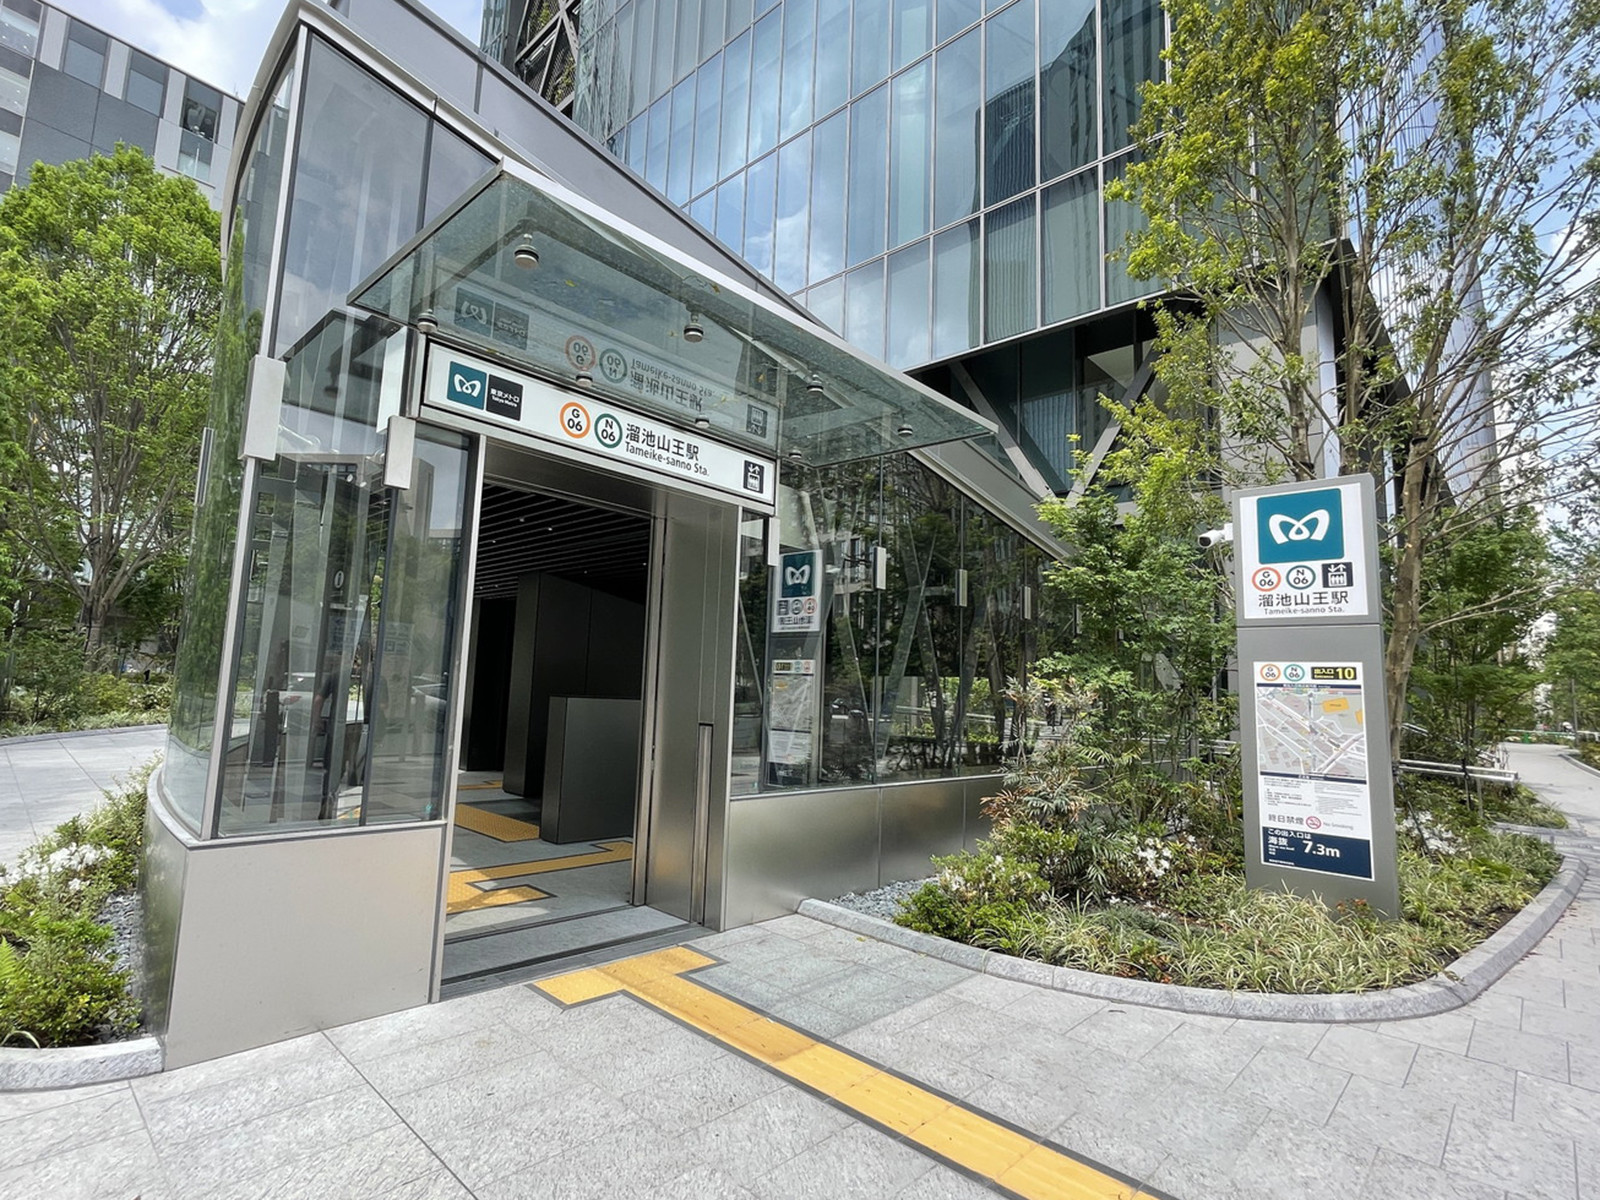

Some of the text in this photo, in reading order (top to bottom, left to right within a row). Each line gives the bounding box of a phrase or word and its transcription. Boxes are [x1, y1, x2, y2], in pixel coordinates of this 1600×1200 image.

[490, 388, 520, 403] 東京メトロ
[571, 408, 580, 419] G
[567, 418, 583, 432] 06
[604, 419, 614, 430] N
[601, 429, 616, 442] 06
[625, 423, 700, 461] 溜池山王駅
[624, 441, 710, 476] Tameike-sanno Sta.
[1262, 571, 1270, 579] G
[1293, 577, 1309, 585] 06
[1259, 579, 1274, 587] 06
[1258, 590, 1349, 607] 溜池山王駅
[1264, 607, 1326, 615] Tameike-sanno
[1336, 667, 1355, 679] 10
[1268, 813, 1304, 825] 終日禁煙
[1268, 828, 1312, 839] この出入口は
[1302, 840, 1340, 858] 7.3m
